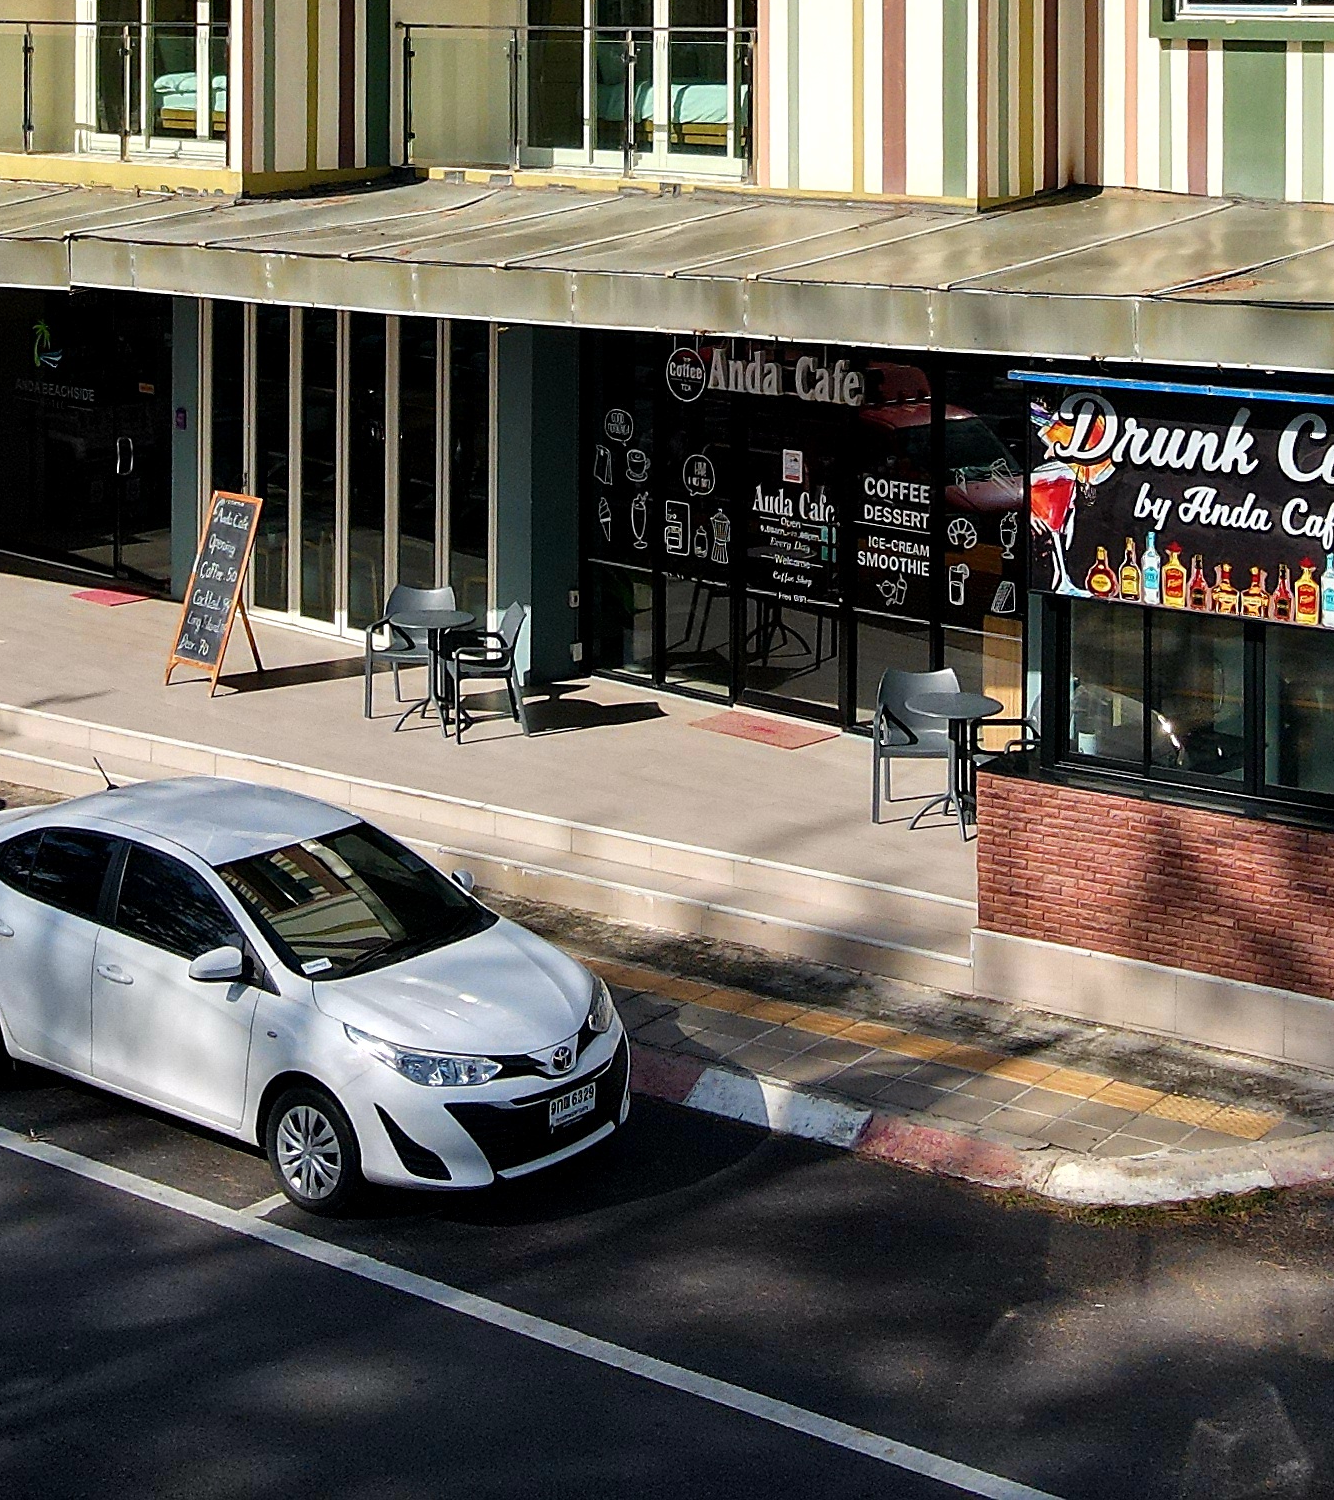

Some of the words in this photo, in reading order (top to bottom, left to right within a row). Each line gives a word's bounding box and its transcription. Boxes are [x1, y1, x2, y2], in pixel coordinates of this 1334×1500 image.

[669, 362, 703, 380] Coffee
[707, 348, 784, 396] Anda
[795, 356, 865, 407] Cafe
[42, 382, 95, 402] BEACHSIDE
[1054, 392, 1259, 476] Drunk
[752, 482, 794, 518] Anda
[864, 476, 931, 504] COFFEE
[864, 504, 930, 529] DESSERT
[1134, 482, 1171, 531] by
[1177, 486, 1272, 532] Anda
[780, 517, 801, 529] Open
[868, 535, 930, 558] ICE-CREAM
[774, 554, 811, 569] Welcome
[857, 550, 930, 577] SMOOTHIE
